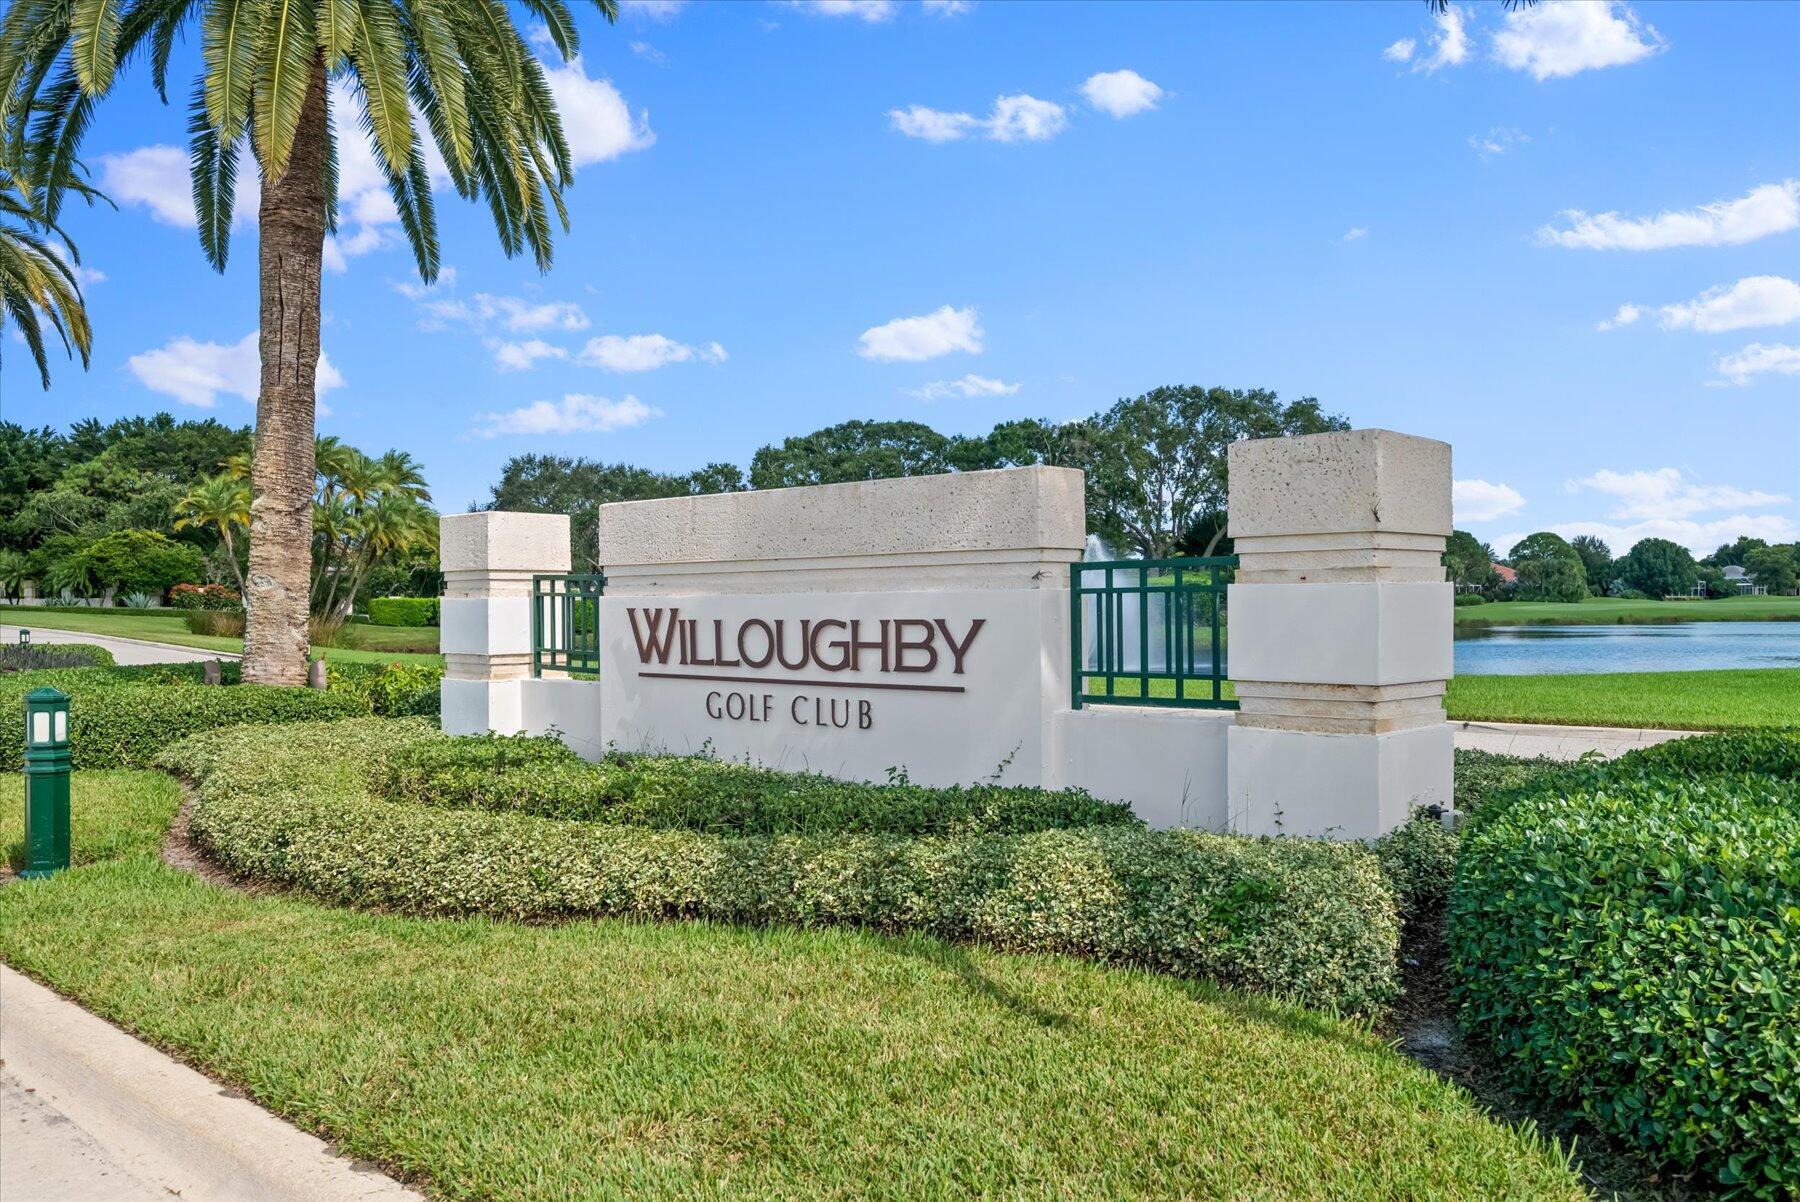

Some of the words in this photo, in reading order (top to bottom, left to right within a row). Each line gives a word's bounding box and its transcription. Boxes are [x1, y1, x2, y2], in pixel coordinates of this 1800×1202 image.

[626, 608, 986, 675] WILLOUGHBY
[706, 691, 773, 722] GOLF
[791, 696, 873, 730] CLUB
